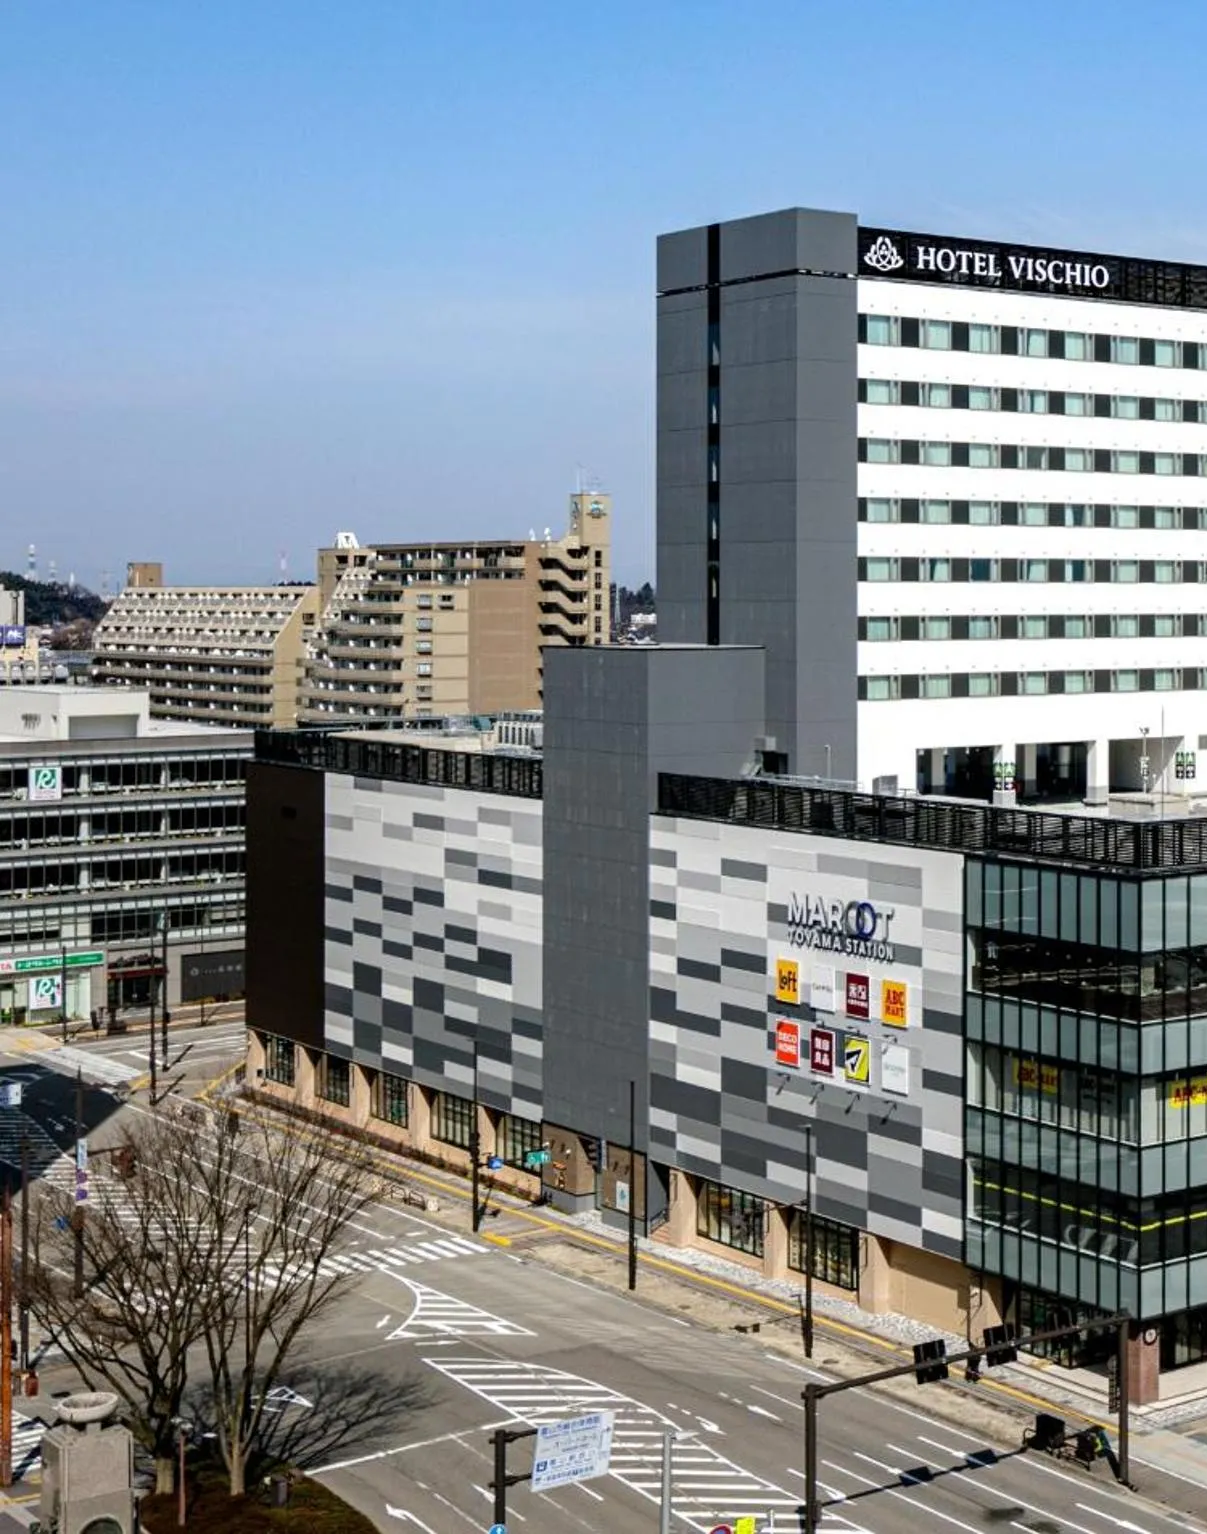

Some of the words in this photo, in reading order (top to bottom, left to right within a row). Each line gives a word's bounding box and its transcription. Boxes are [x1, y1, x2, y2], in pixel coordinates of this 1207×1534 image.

[916, 246, 1002, 277] HOTEL
[1008, 256, 1109, 287] VISCHIO
[787, 892, 895, 942] MAROOT
[787, 927, 842, 952] TOYAMA
[845, 938, 895, 962] STATION
[886, 989, 904, 1006] ABC
